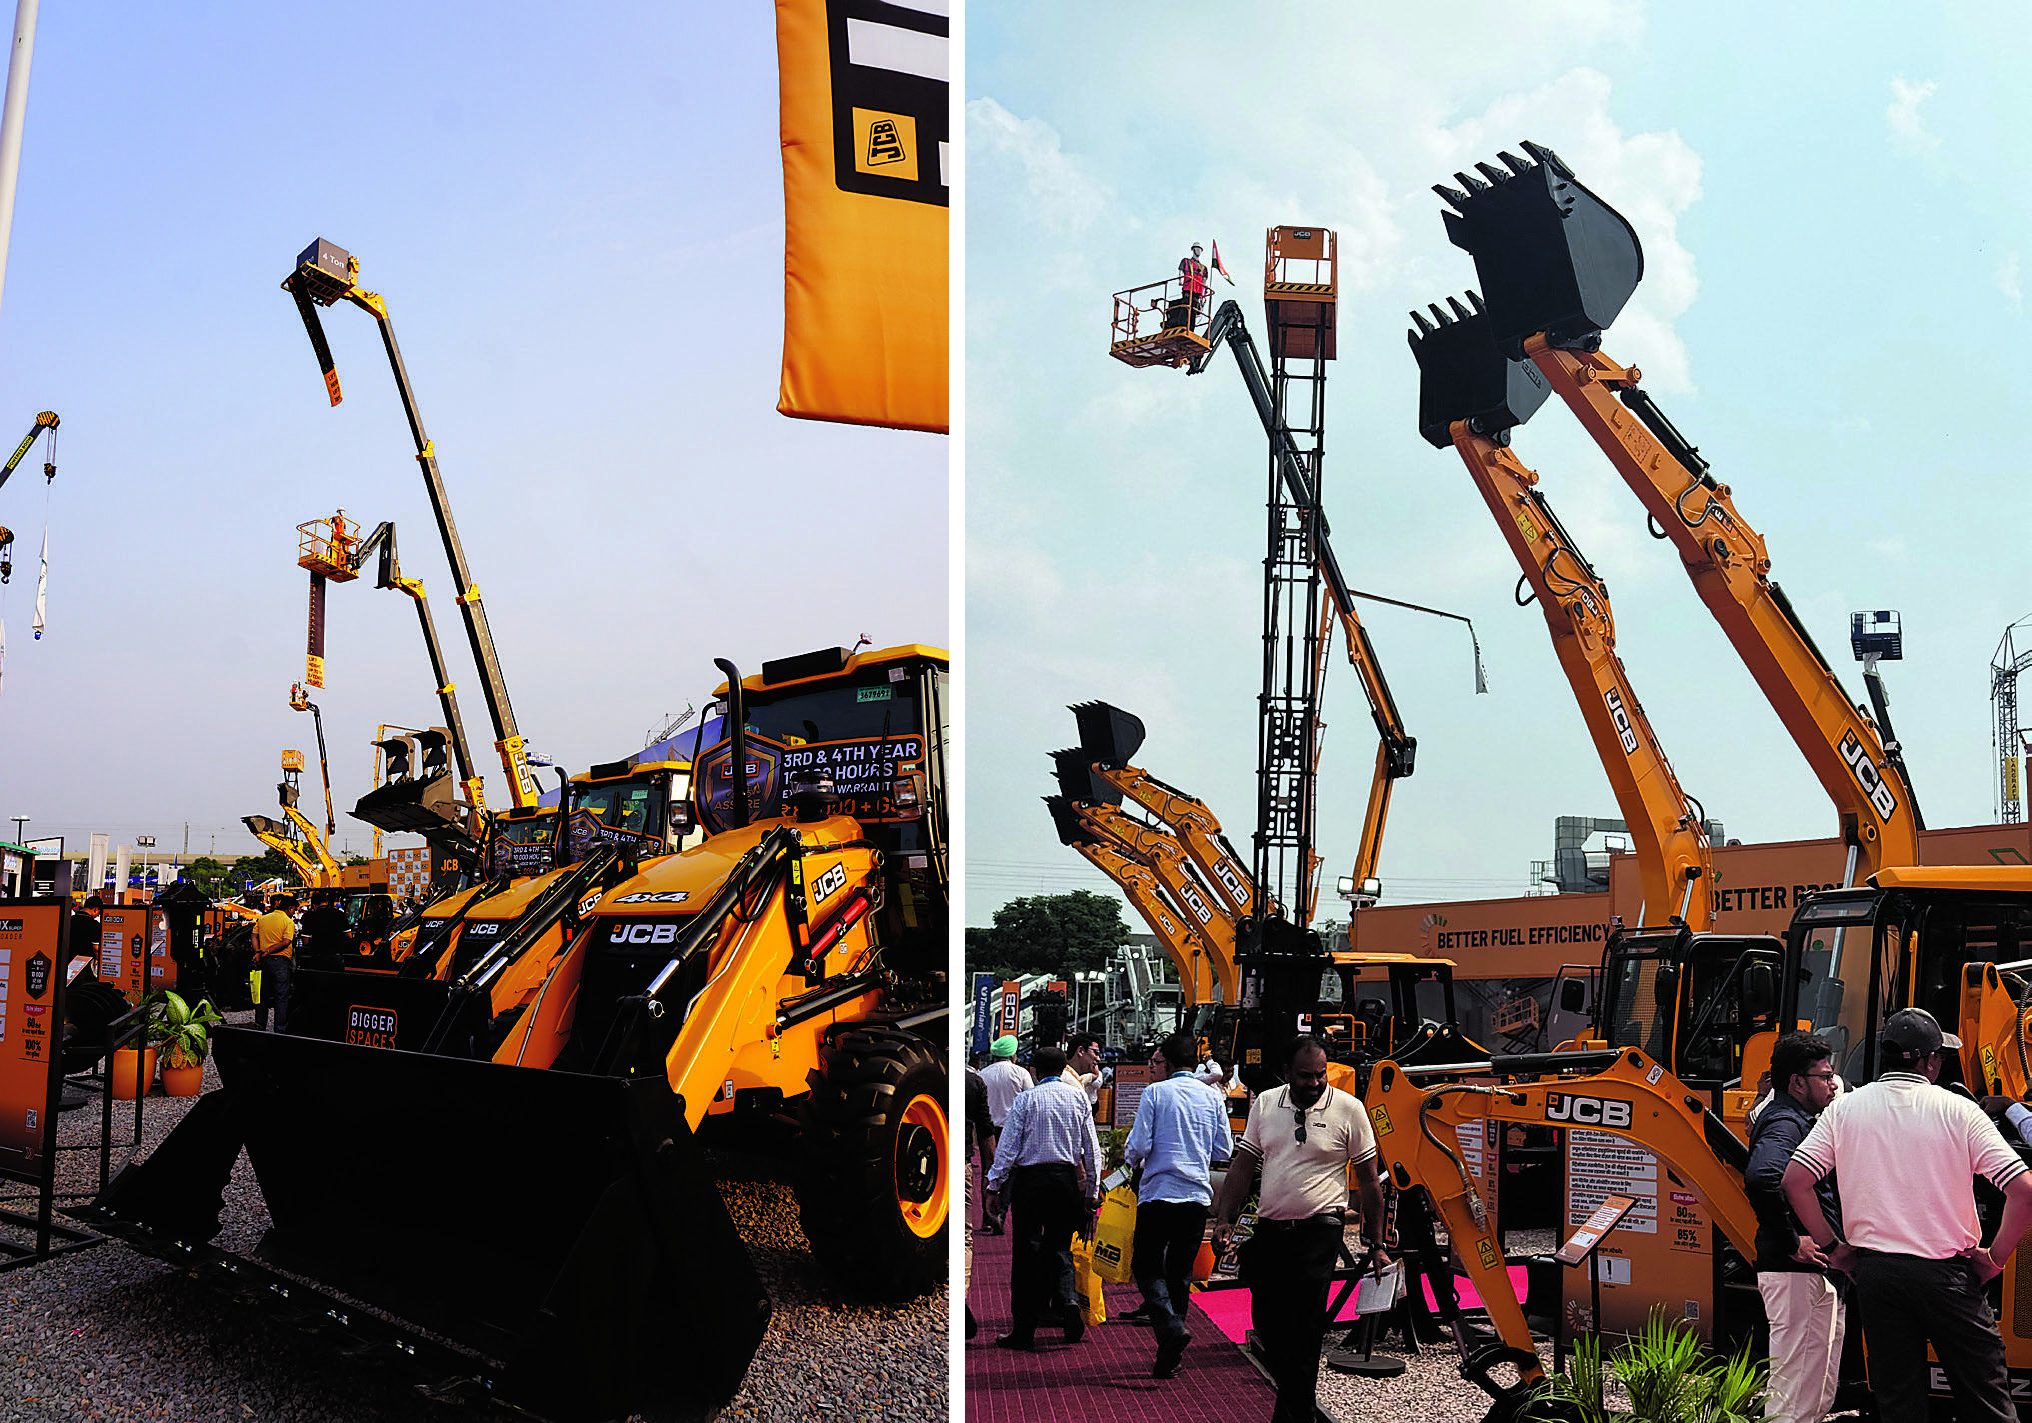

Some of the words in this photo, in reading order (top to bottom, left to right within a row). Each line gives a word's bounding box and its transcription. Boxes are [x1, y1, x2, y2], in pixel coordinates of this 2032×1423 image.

[870, 122, 902, 159] JCB
[322, 252, 329, 261] 4
[329, 255, 345, 269] Ton
[1605, 688, 1639, 754] JCB
[783, 751, 813, 768] 3RD
[815, 750, 828, 764] &
[831, 746, 865, 762] 4TH
[869, 742, 918, 759] YEAR
[513, 753, 533, 795] JCB
[724, 763, 757, 775] JB
[836, 762, 893, 781] HOURS
[1840, 731, 1896, 820] JCB
[572, 827, 588, 836] JCB
[440, 858, 459, 872] JCB
[813, 865, 847, 903] JCB
[1214, 860, 1249, 906] JCB
[1181, 884, 1213, 924] JCB
[469, 923, 499, 935] JCB
[609, 923, 679, 944] JCB
[1159, 914, 1175, 935] JCB
[1437, 930, 1488, 950] BETTER
[1491, 928, 1526, 947] FUEL
[1529, 923, 1611, 945] EFFICIENCY
[351, 1011, 394, 1032] BIGGER
[1004, 993, 1016, 1029] JCB
[1547, 1095, 1631, 1127] JCB
[1677, 1228, 1697, 1242] 85%
